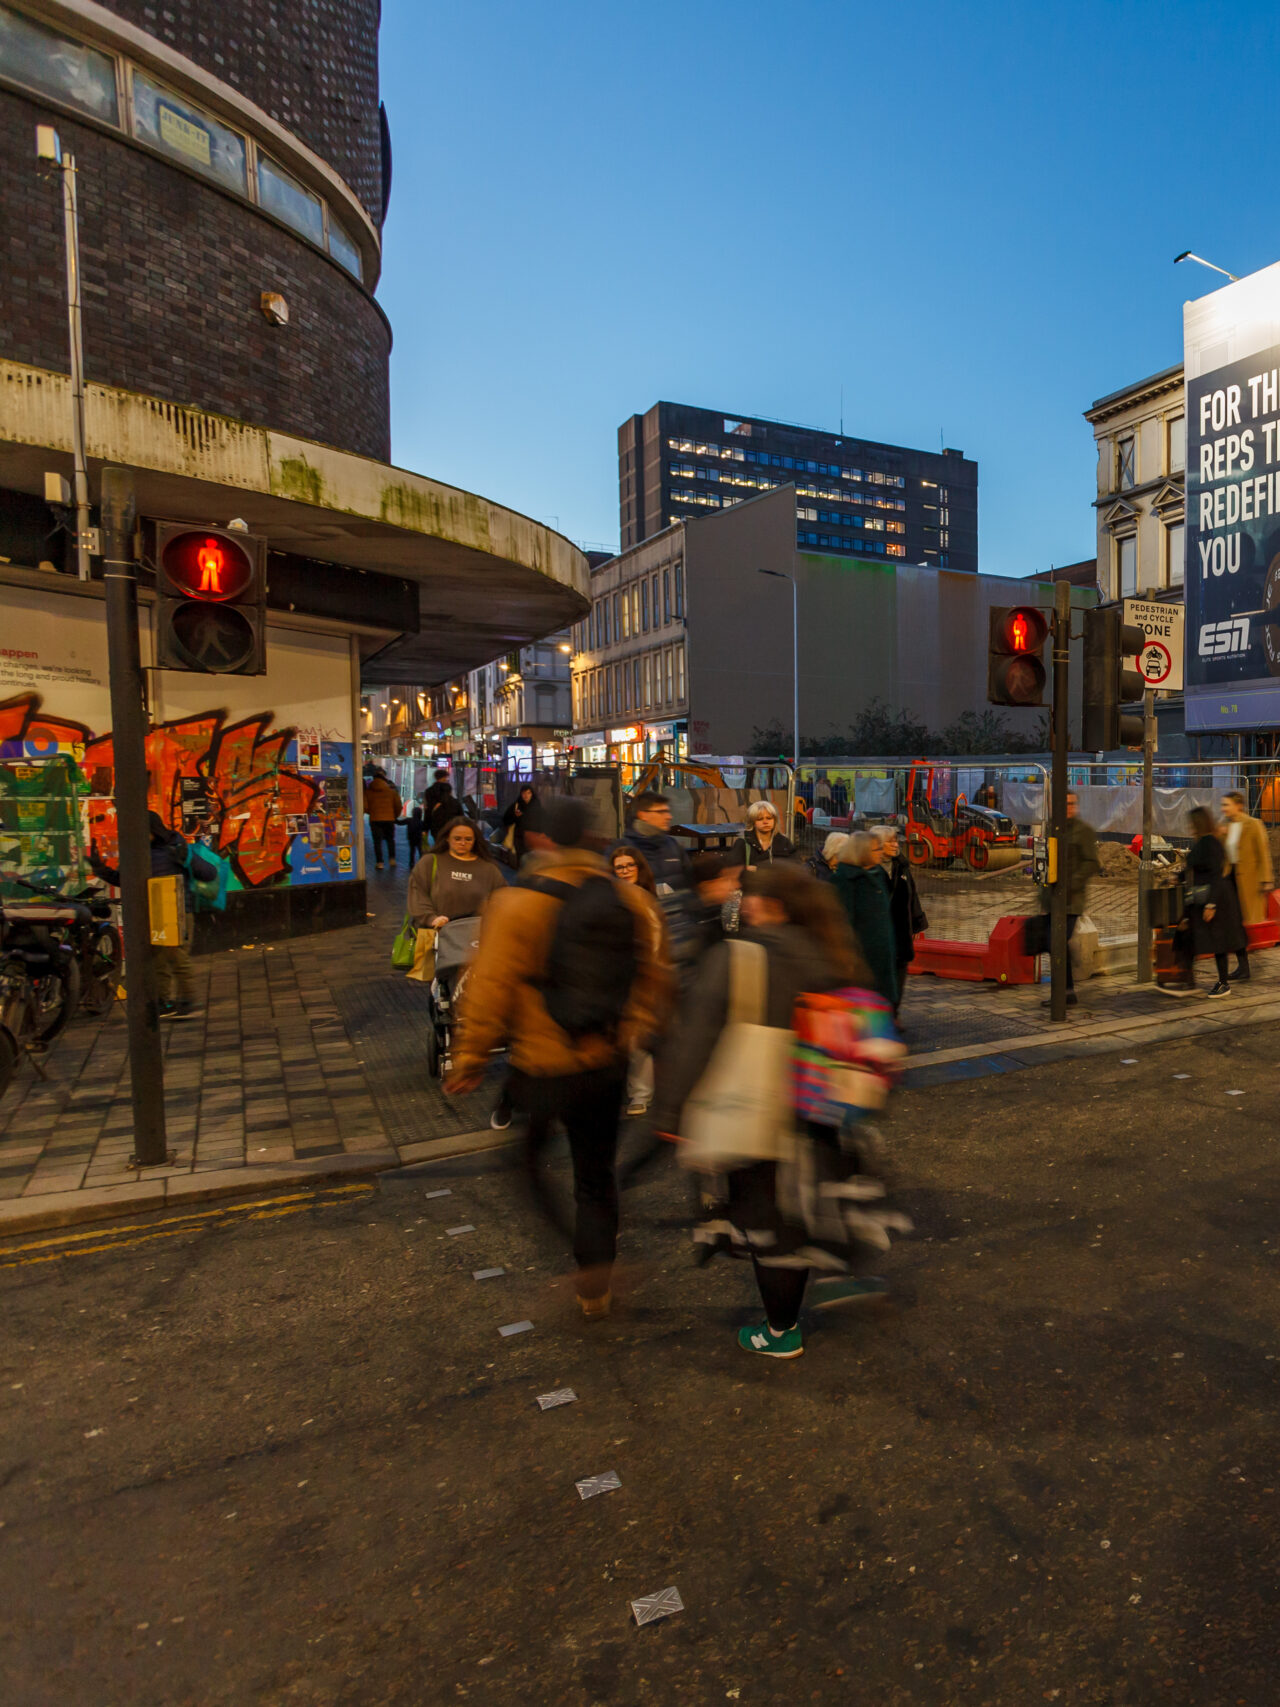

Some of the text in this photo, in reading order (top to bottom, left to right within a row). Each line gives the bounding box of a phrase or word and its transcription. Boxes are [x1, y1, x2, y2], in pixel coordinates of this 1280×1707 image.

[1200, 384, 1241, 437] FOR
[1200, 429, 1254, 484] REPS
[1199, 532, 1241, 580] YOU
[1130, 603, 1179, 616] PEDESTRIAN
[1134, 613, 1174, 624] and CYCLE
[0, 648, 39, 659] appen
[451, 871, 473, 880] NIKE
[151, 930, 167, 942] 24
